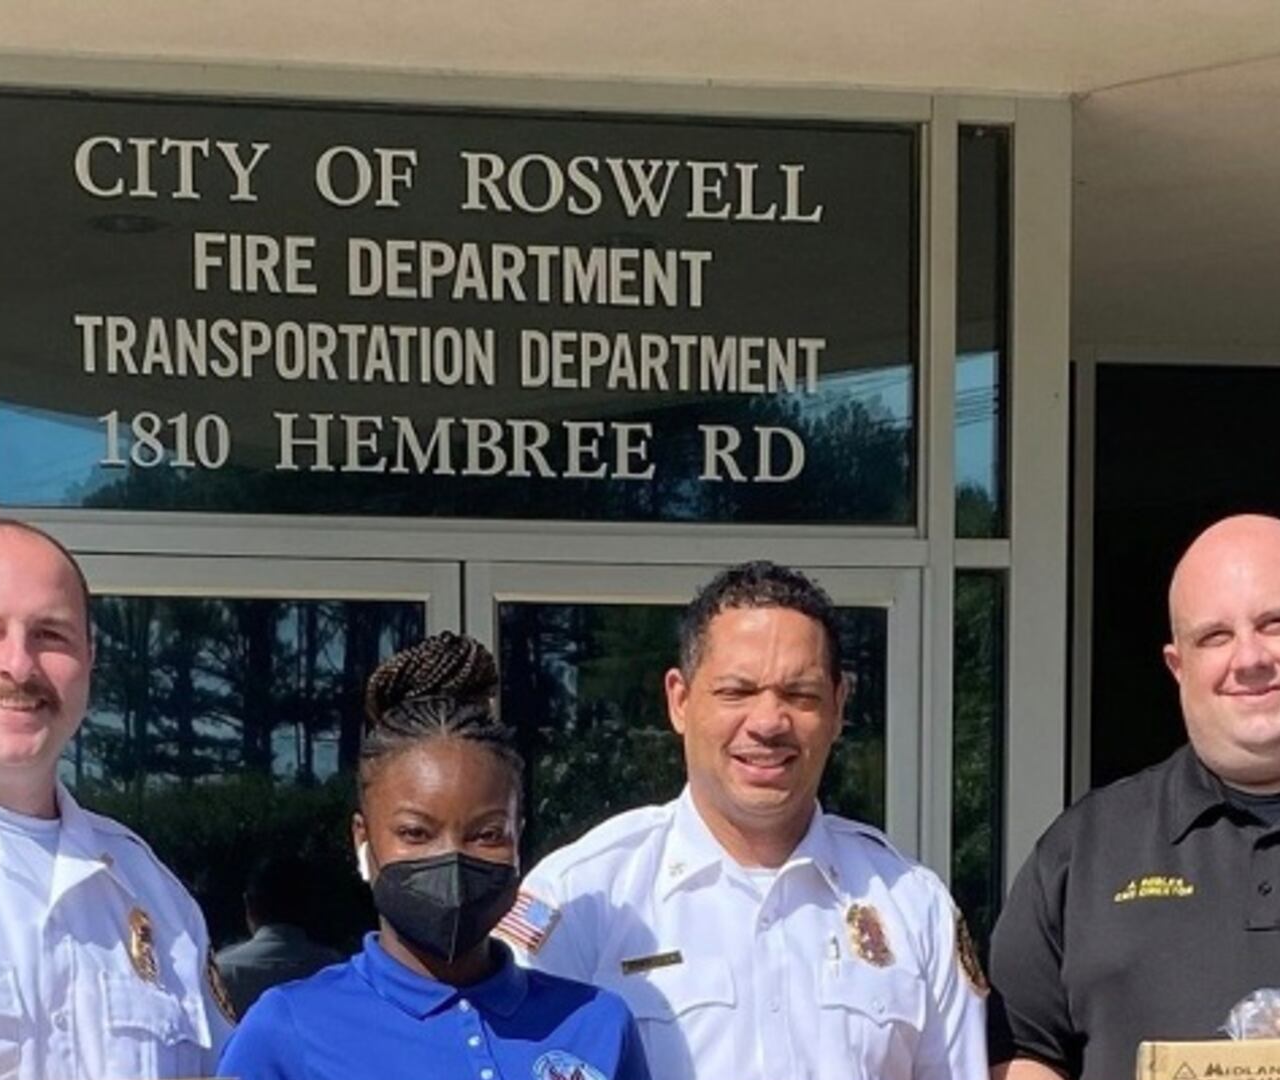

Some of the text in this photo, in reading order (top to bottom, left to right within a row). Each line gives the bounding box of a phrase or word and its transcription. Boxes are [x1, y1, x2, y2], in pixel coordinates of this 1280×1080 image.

[74, 136, 823, 223] CITY OF ROSWELL
[193, 232, 712, 308] FIRE DEPARTMENT
[74, 315, 826, 393] TRANSPORTATION DEPARTMENT
[98, 410, 806, 482] 1810 HEMBREE RD
